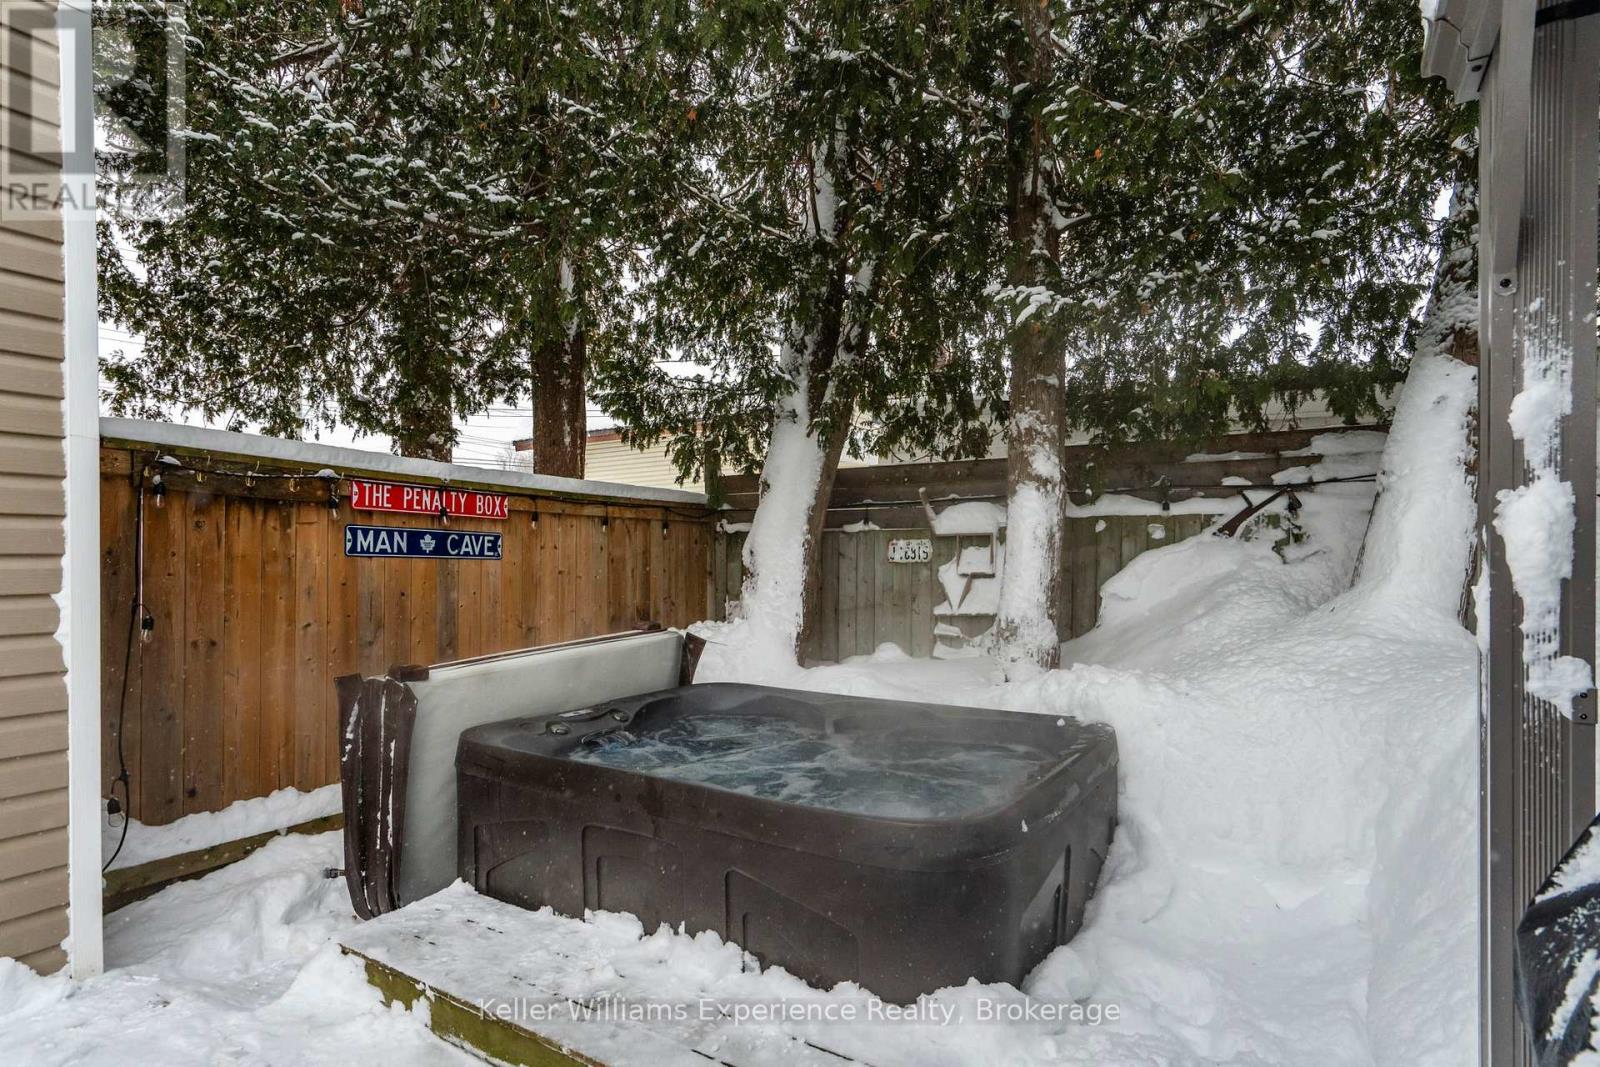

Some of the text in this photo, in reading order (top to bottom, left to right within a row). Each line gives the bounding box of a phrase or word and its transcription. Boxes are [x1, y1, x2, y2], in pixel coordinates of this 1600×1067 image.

[363, 483, 501, 516] THE PENALTY BOX
[357, 529, 495, 556] MAN CAVE
